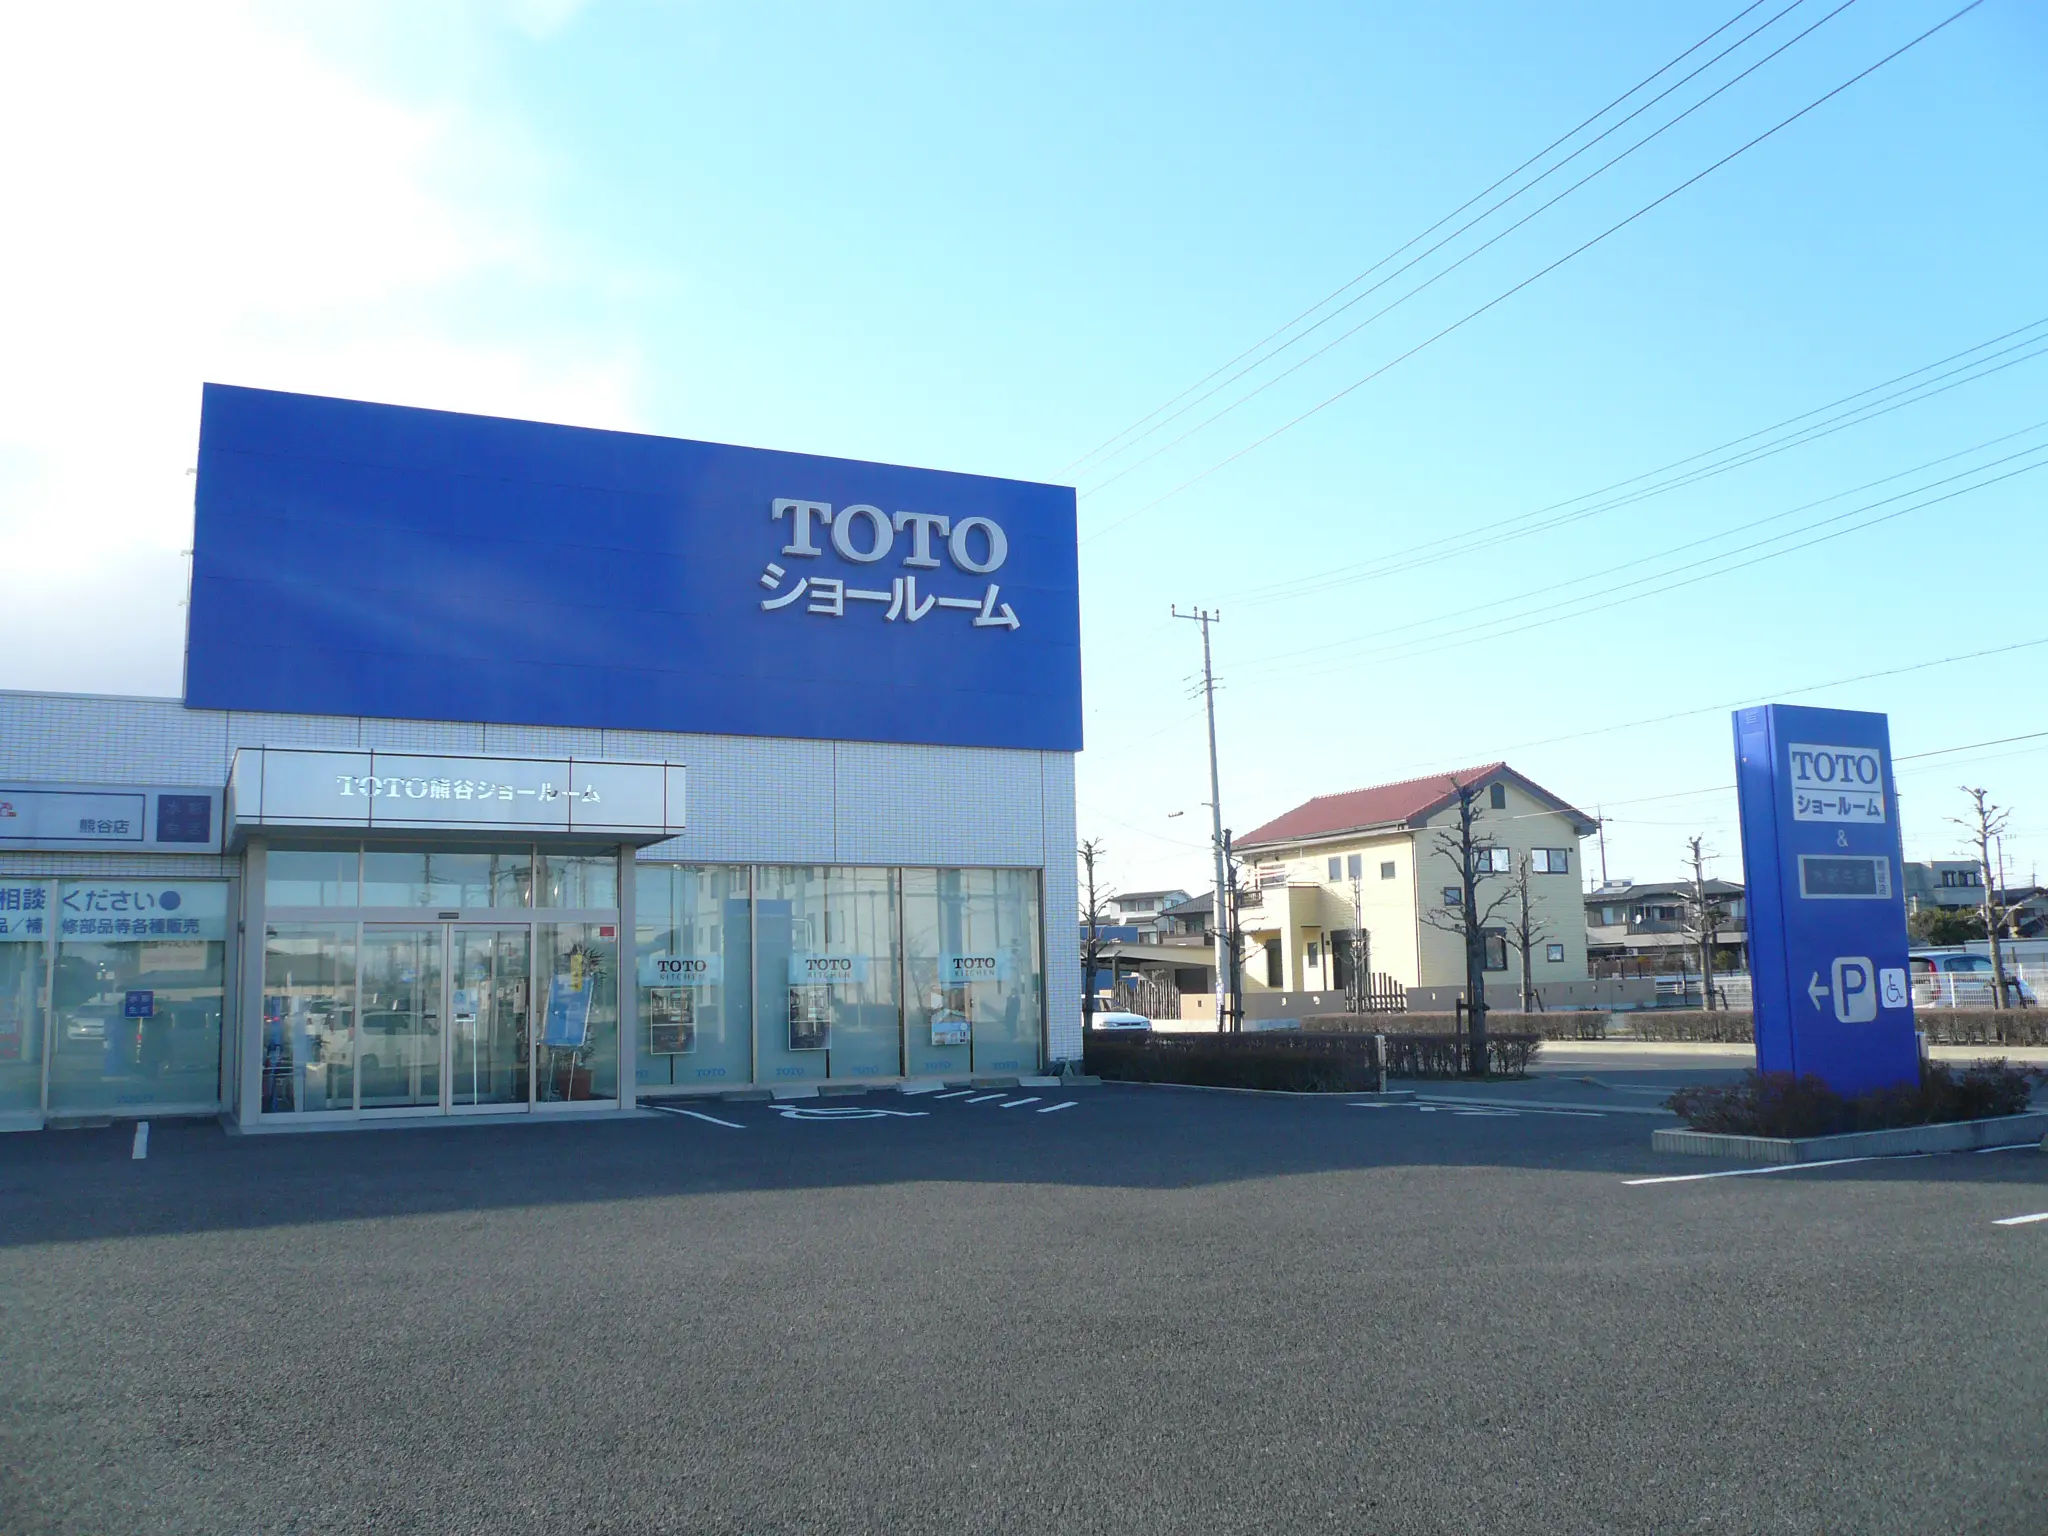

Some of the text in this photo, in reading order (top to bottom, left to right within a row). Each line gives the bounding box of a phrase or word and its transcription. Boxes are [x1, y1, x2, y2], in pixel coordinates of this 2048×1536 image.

[772, 498, 1008, 573] TOTO
[760, 563, 1021, 630] ショールーム
[1792, 750, 1878, 785] TOTO
[336, 775, 601, 803] TOTO熊谷ショールーム
[1797, 795, 1881, 817] ショールーム
[79, 818, 130, 834] 熊谷店
[1836, 829, 1849, 847] &
[0, 887, 156, 912] 相談 ください
[62, 917, 200, 935] 修部品等各種販売
[657, 960, 707, 973] TOTO
[806, 958, 852, 971] TOTO
[953, 957, 996, 970] TOTO
[1841, 964, 1867, 1016] P
